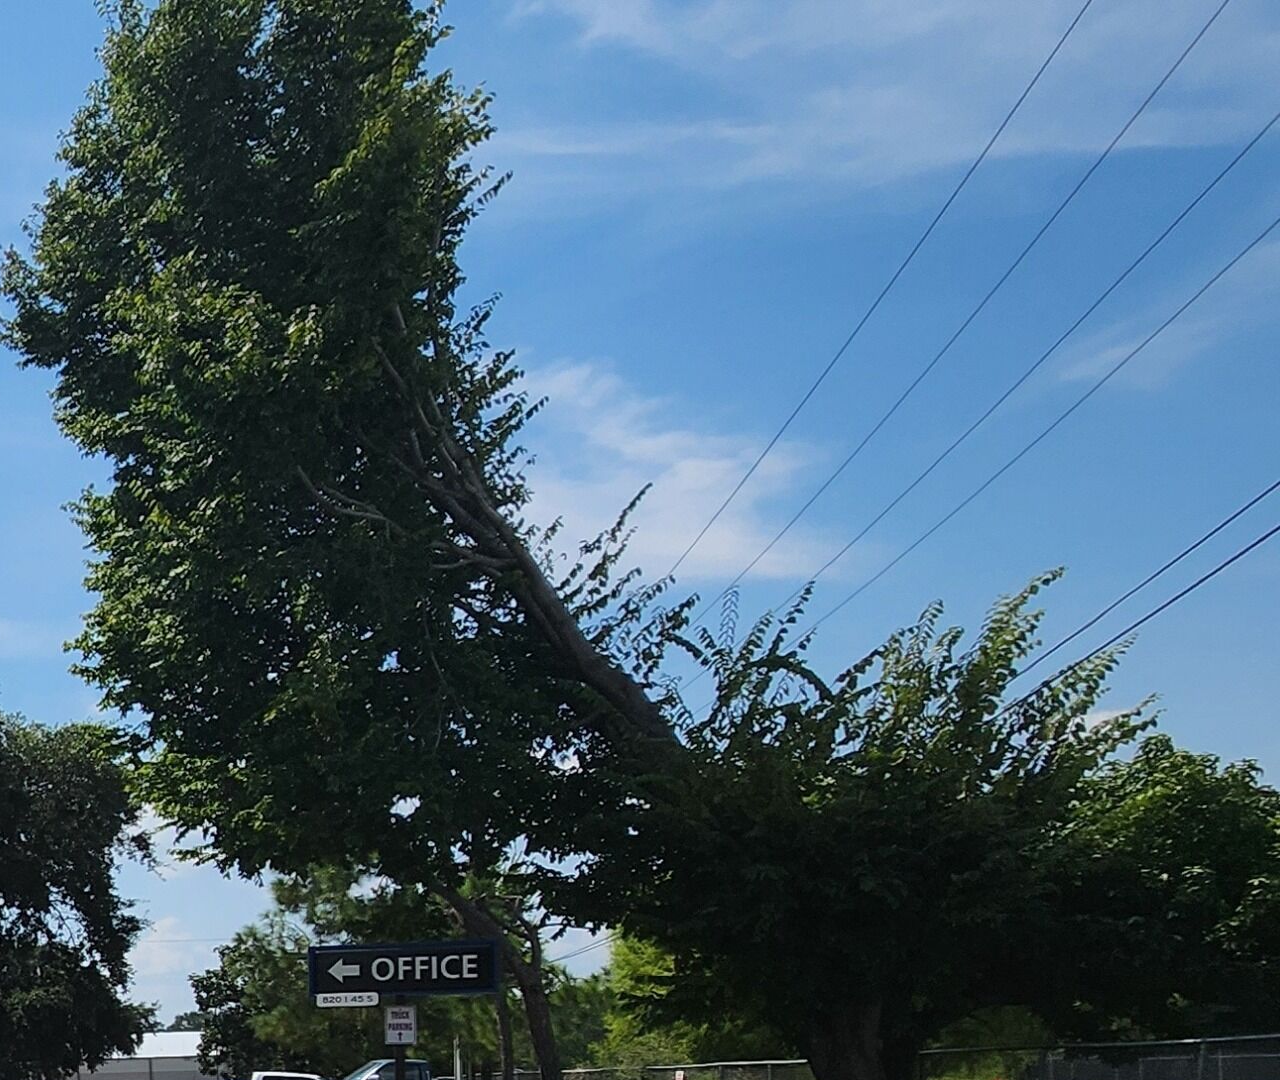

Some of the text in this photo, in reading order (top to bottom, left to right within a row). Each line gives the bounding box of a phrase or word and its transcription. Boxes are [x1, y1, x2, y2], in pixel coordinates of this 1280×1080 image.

[371, 954, 479, 981] OFFICE
[391, 1011, 409, 1019] TRUCK
[388, 1023, 413, 1031] PARKING
